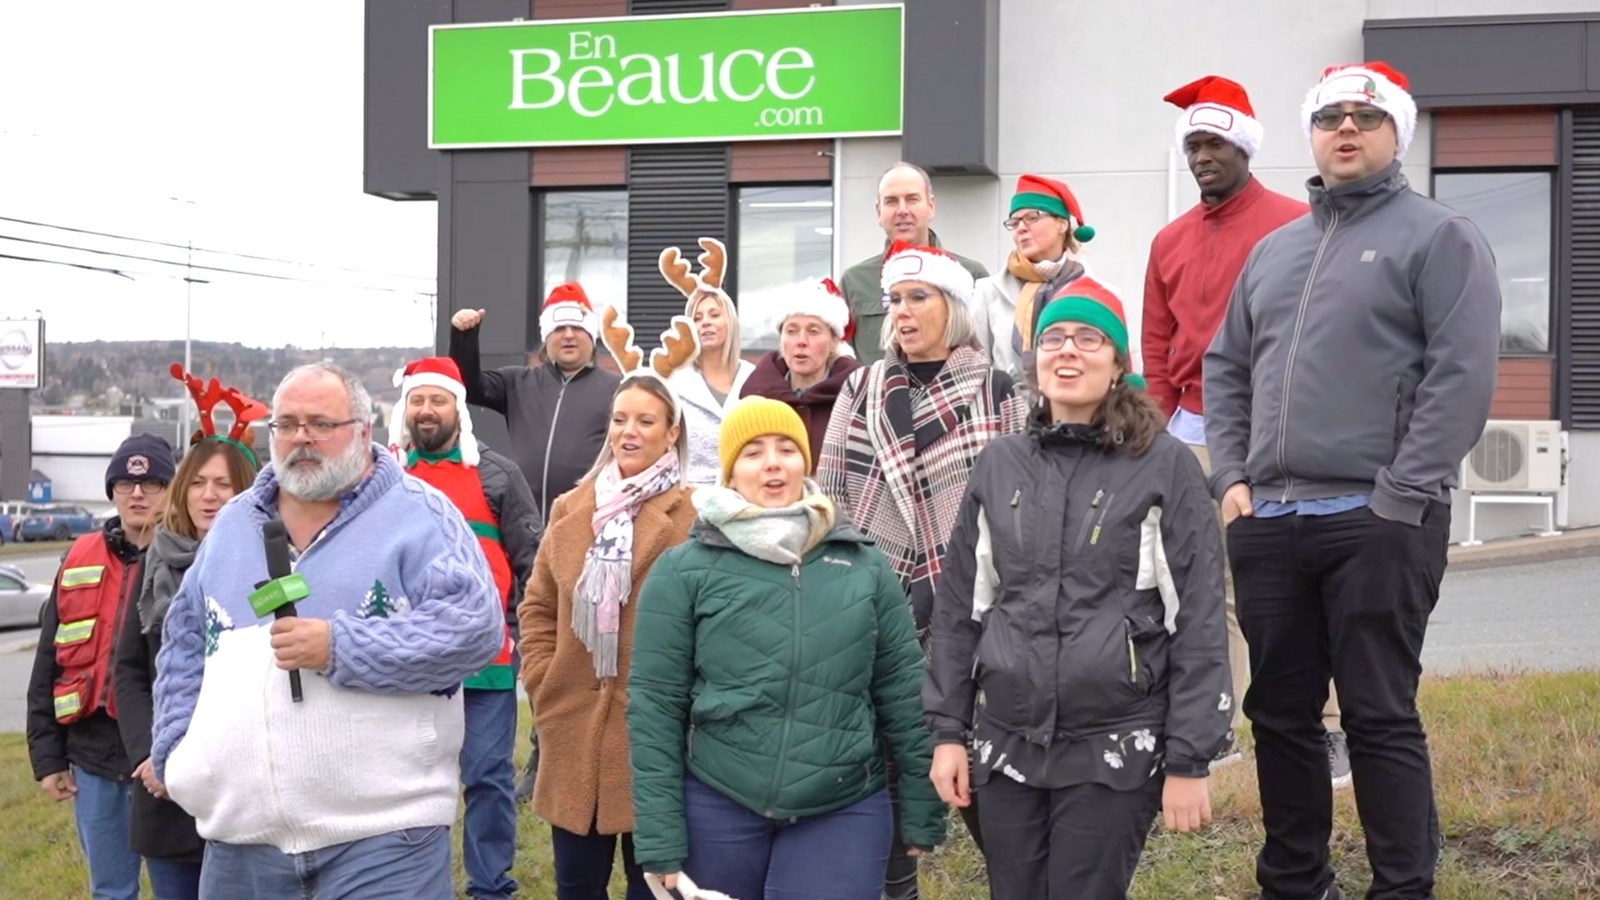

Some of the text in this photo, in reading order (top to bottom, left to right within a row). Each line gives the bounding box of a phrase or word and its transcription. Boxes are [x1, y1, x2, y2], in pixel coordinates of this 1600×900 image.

[569, 31, 616, 59] En
[508, 47, 816, 117] Beauce
[754, 106, 823, 127] .com
